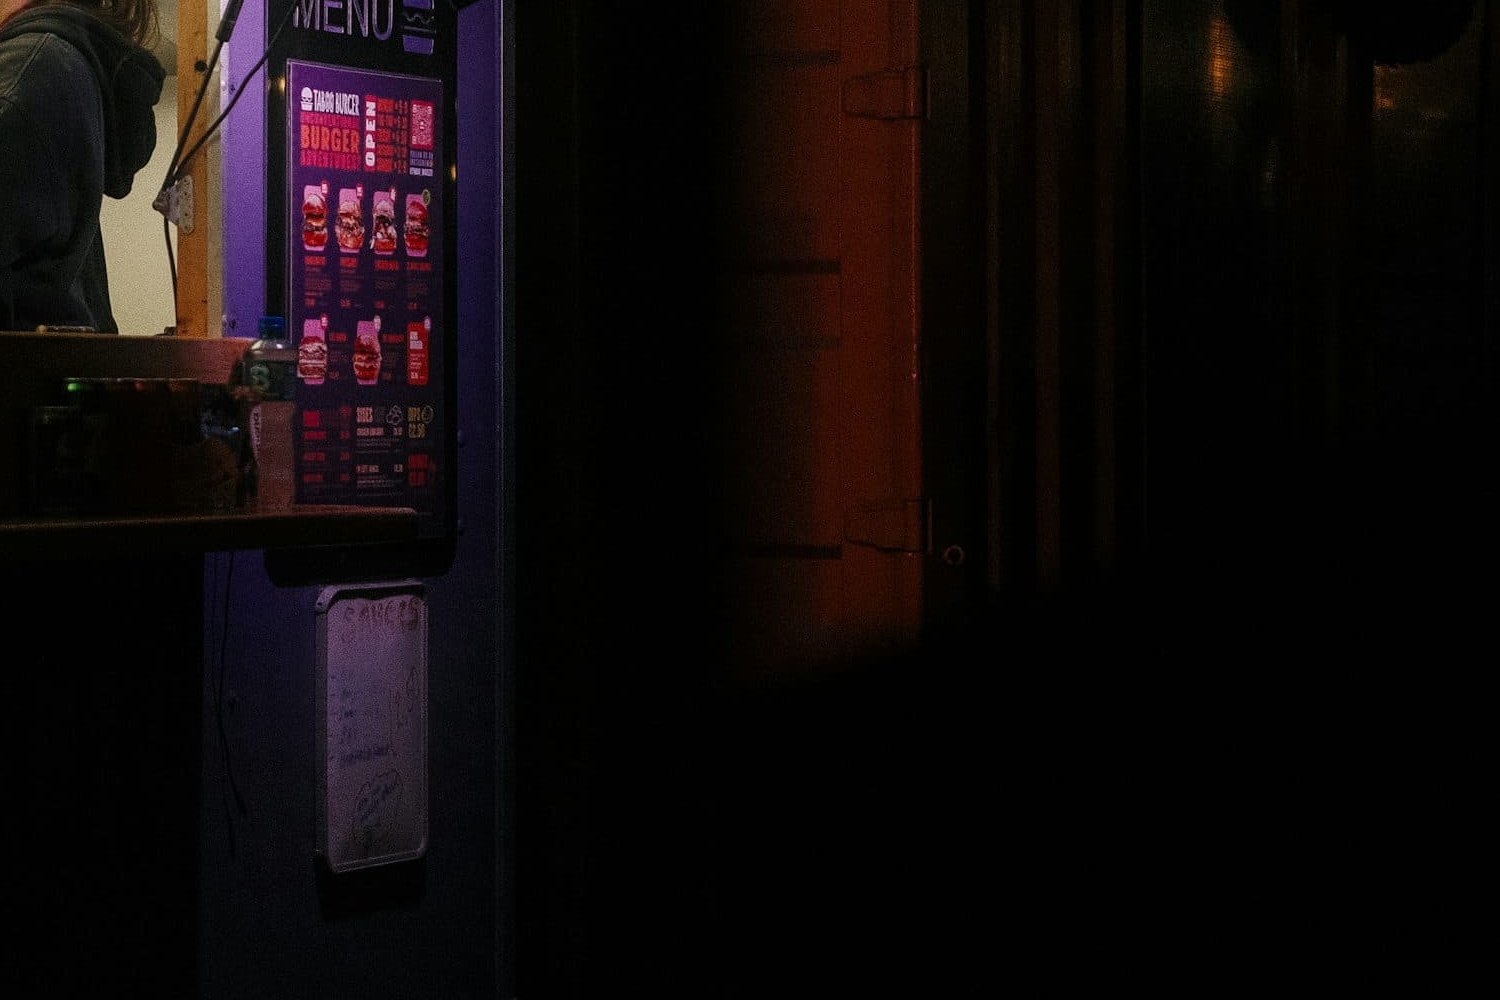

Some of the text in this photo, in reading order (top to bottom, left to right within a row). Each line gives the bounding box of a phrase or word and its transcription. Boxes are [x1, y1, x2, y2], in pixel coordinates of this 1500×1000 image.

[335, 92, 360, 117] BURGER
[301, 123, 360, 154] BURGER
[365, 101, 376, 167] OPEN
